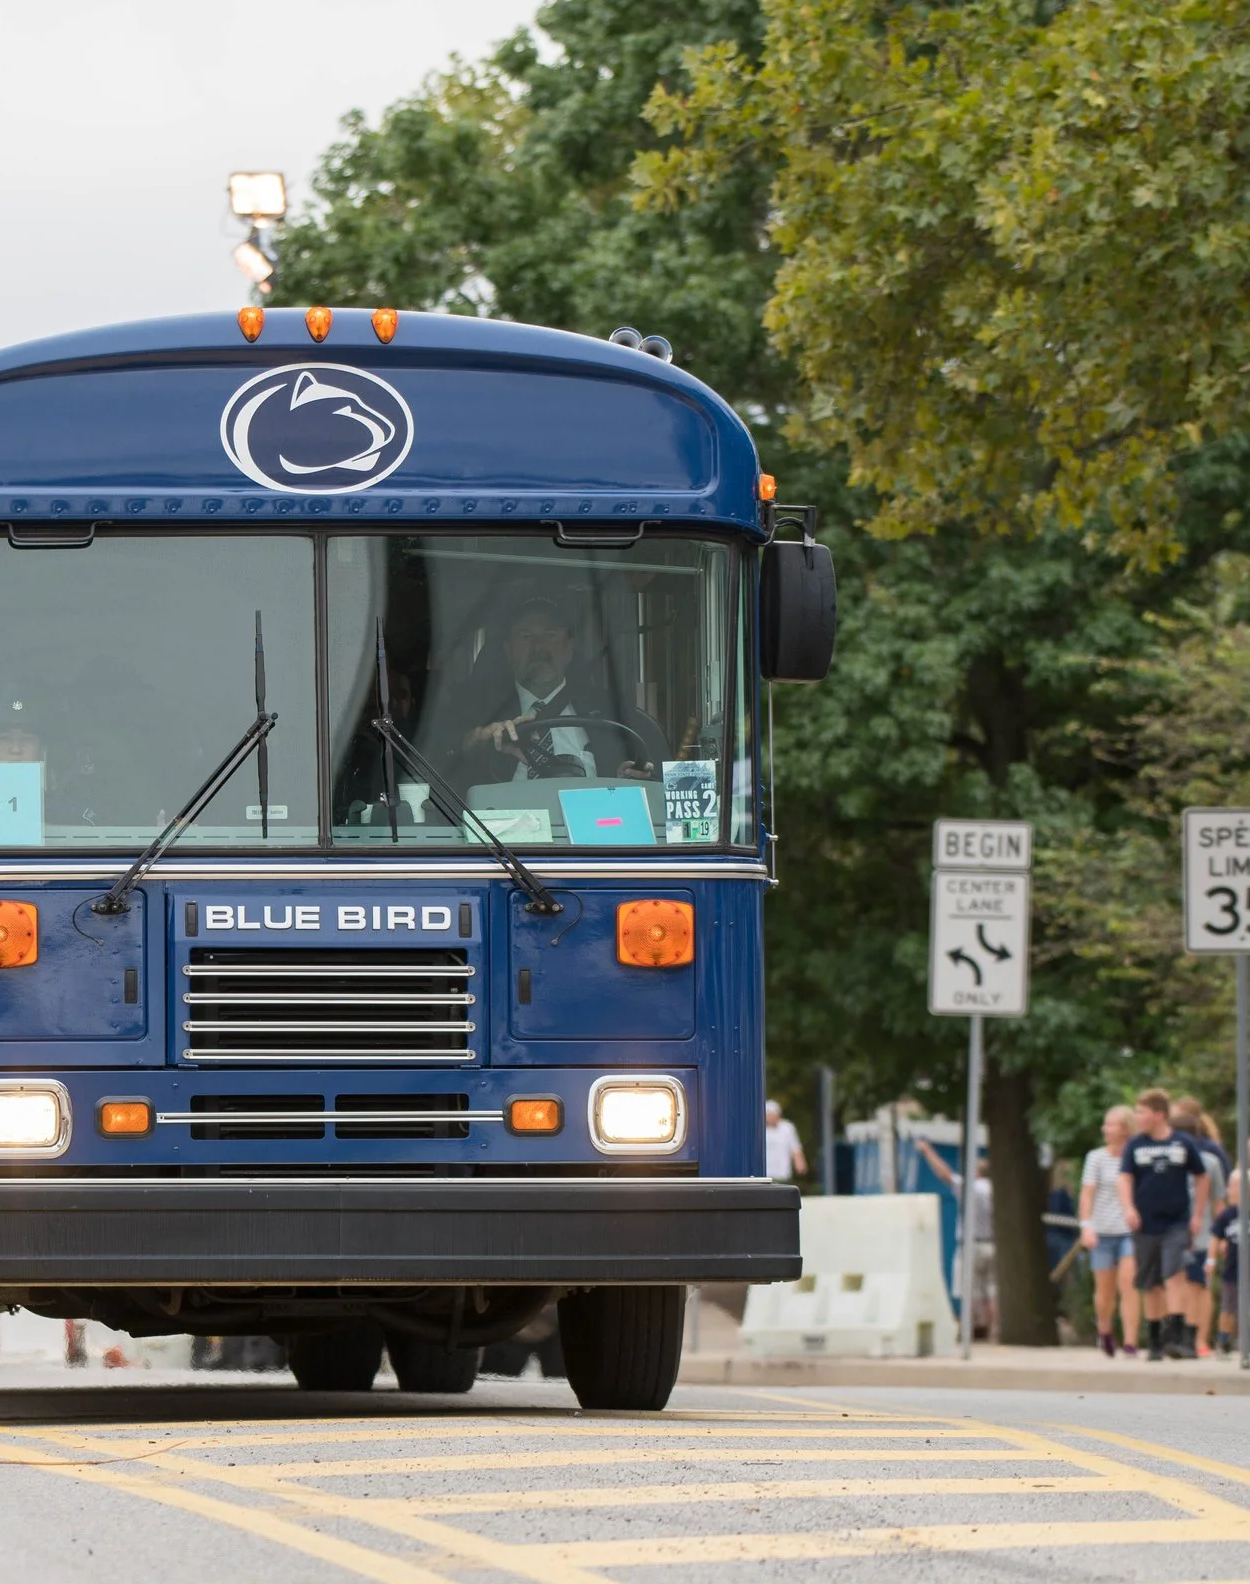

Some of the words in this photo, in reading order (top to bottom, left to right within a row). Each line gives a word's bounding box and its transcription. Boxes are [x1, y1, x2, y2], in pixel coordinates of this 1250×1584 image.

[665, 790, 698, 800] WORKING
[702, 790, 717, 817] 2
[7, 796, 18, 813] 1
[666, 801, 700, 819] PASS
[946, 832, 1021, 858] BEGIN
[1199, 827, 1250, 848] SPE
[946, 880, 1016, 895] CENTER
[956, 898, 1004, 912] LANE
[1203, 886, 1250, 935] 3
[206, 905, 321, 930] BLUE
[337, 906, 452, 931] BIRD
[953, 991, 1001, 1006] ONLY
